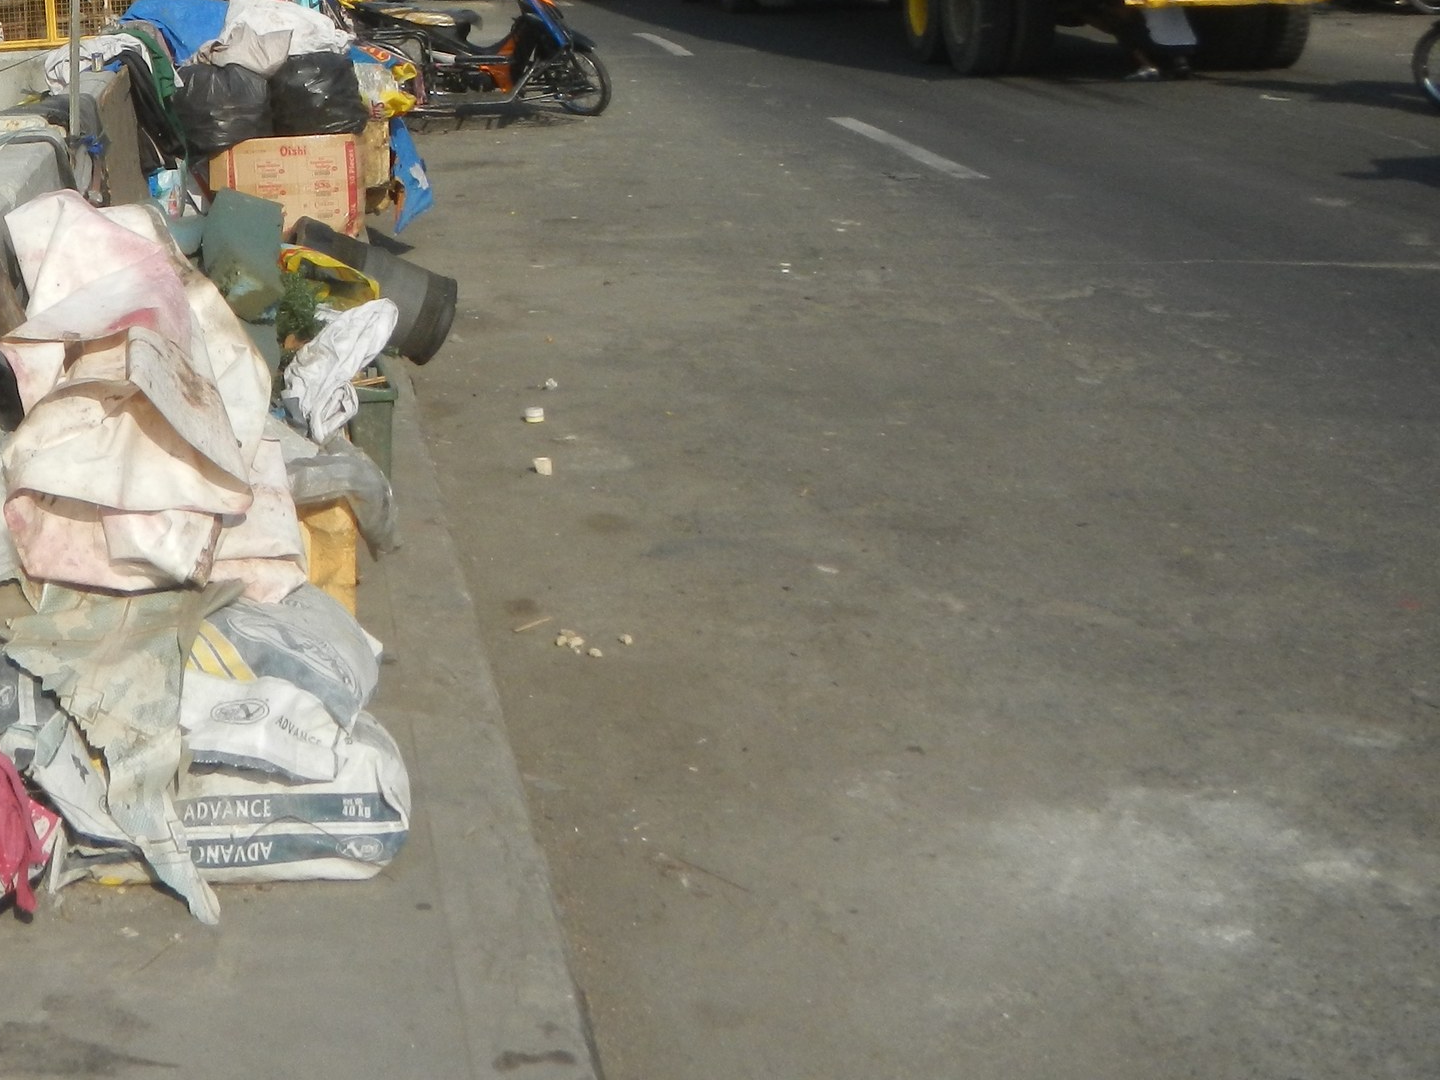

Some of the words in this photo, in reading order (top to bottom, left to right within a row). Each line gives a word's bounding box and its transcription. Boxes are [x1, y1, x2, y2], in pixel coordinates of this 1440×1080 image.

[279, 144, 307, 157] Oishi
[183, 798, 273, 821] ADVANCE
[342, 805, 356, 818] 40
[189, 840, 274, 865] ADVANC
